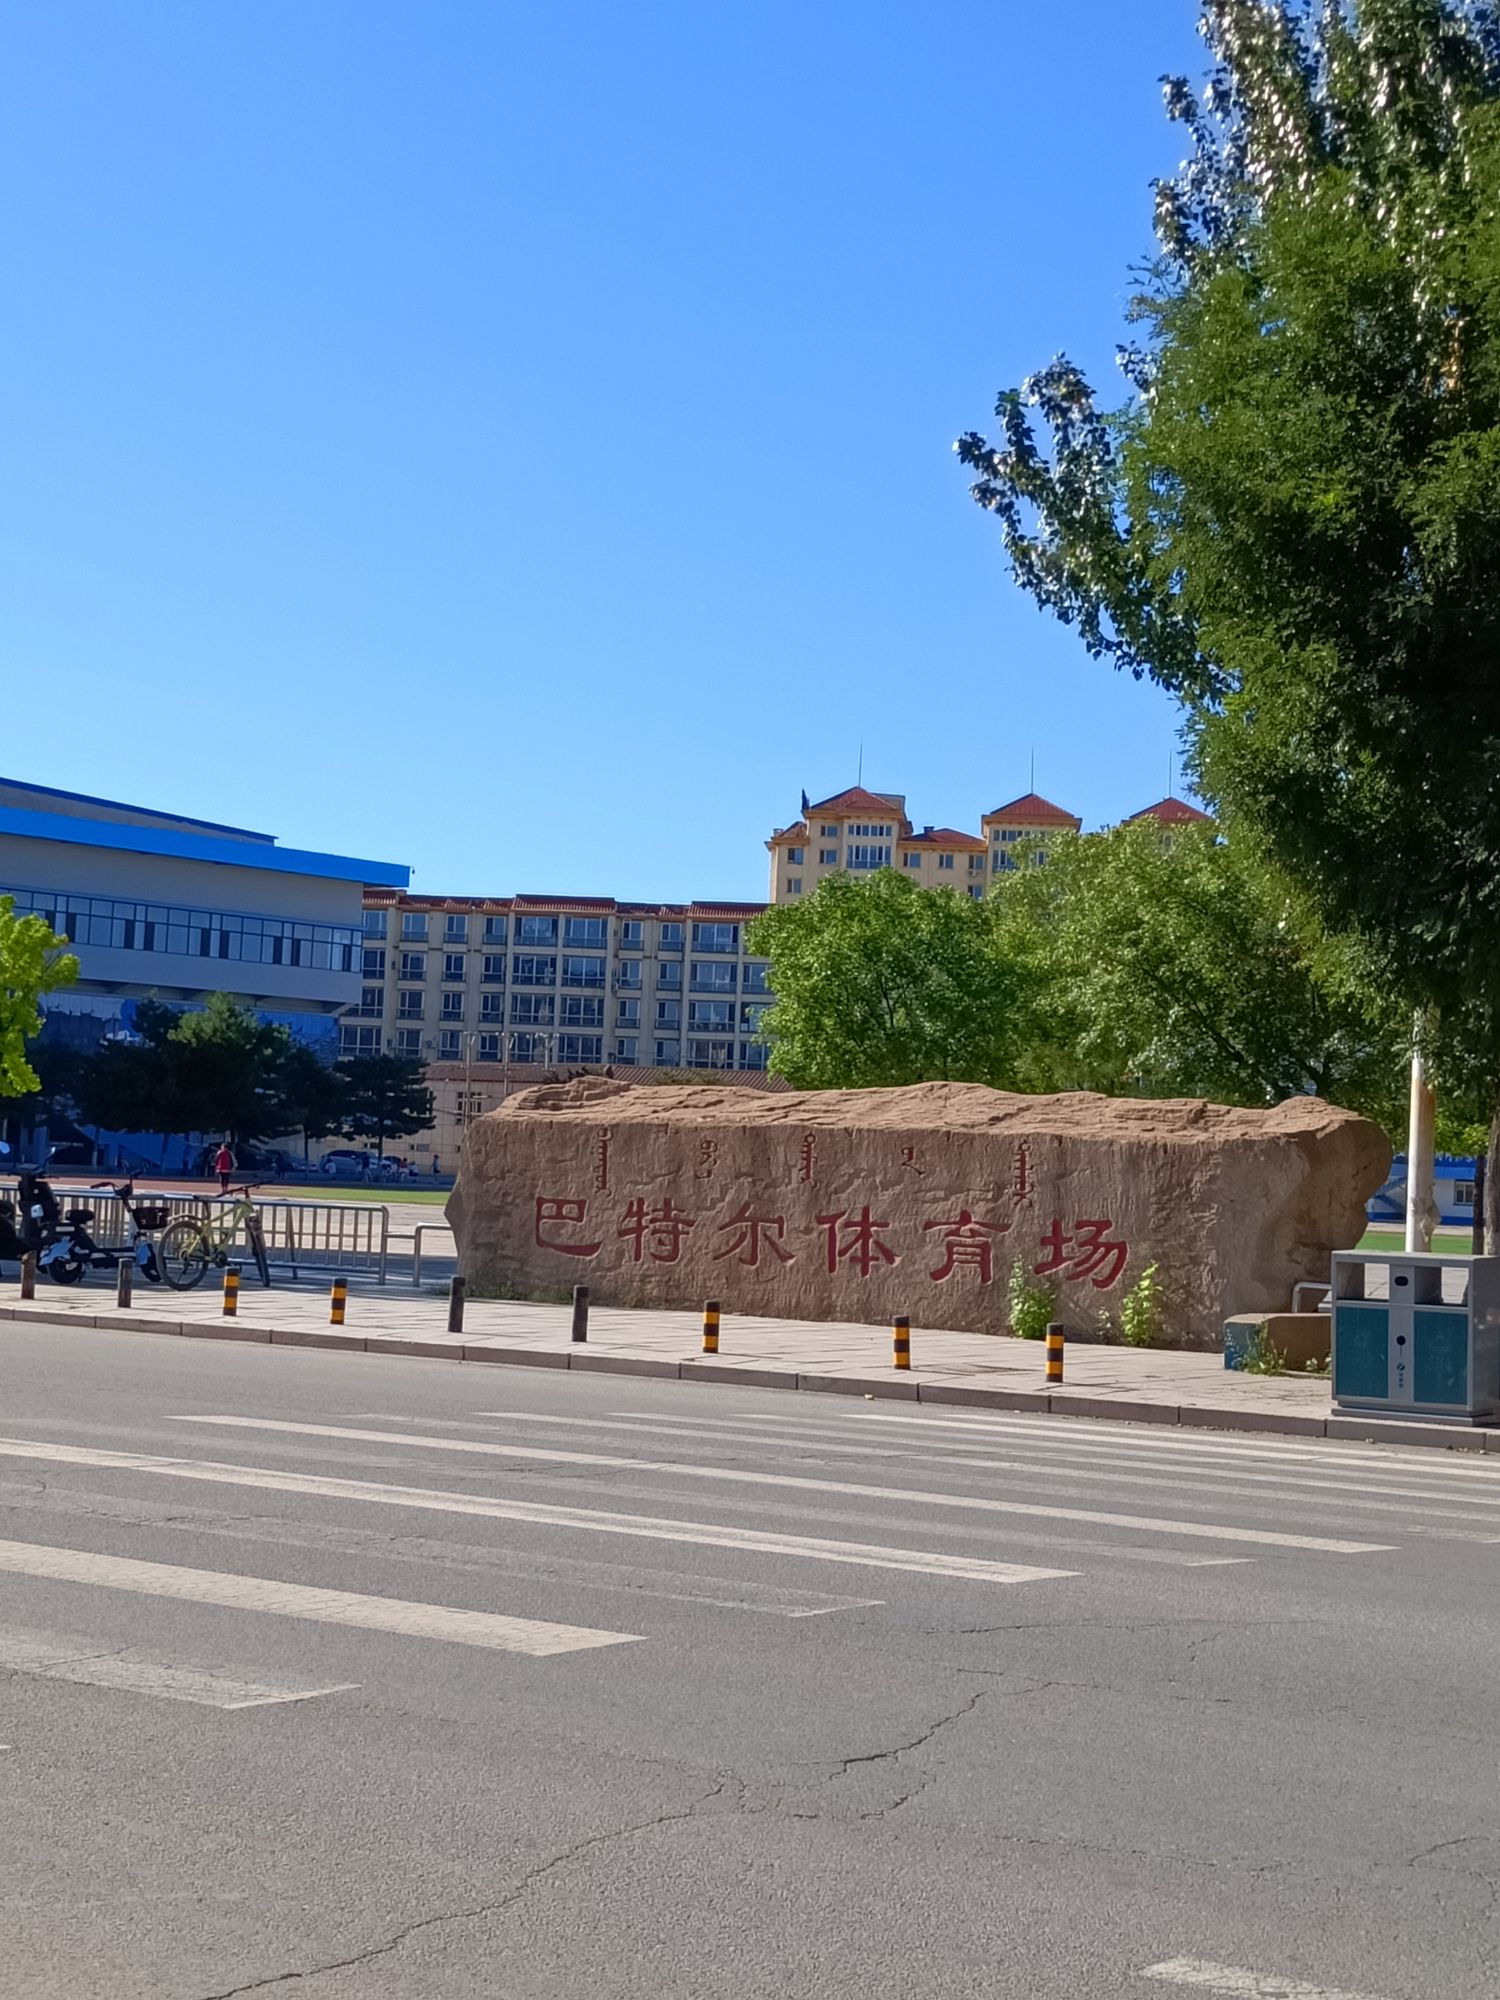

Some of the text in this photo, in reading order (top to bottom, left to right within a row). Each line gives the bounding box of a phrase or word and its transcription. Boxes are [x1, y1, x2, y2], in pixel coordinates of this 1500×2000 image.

[535, 1196, 1129, 1289] 巴特尔体育场
